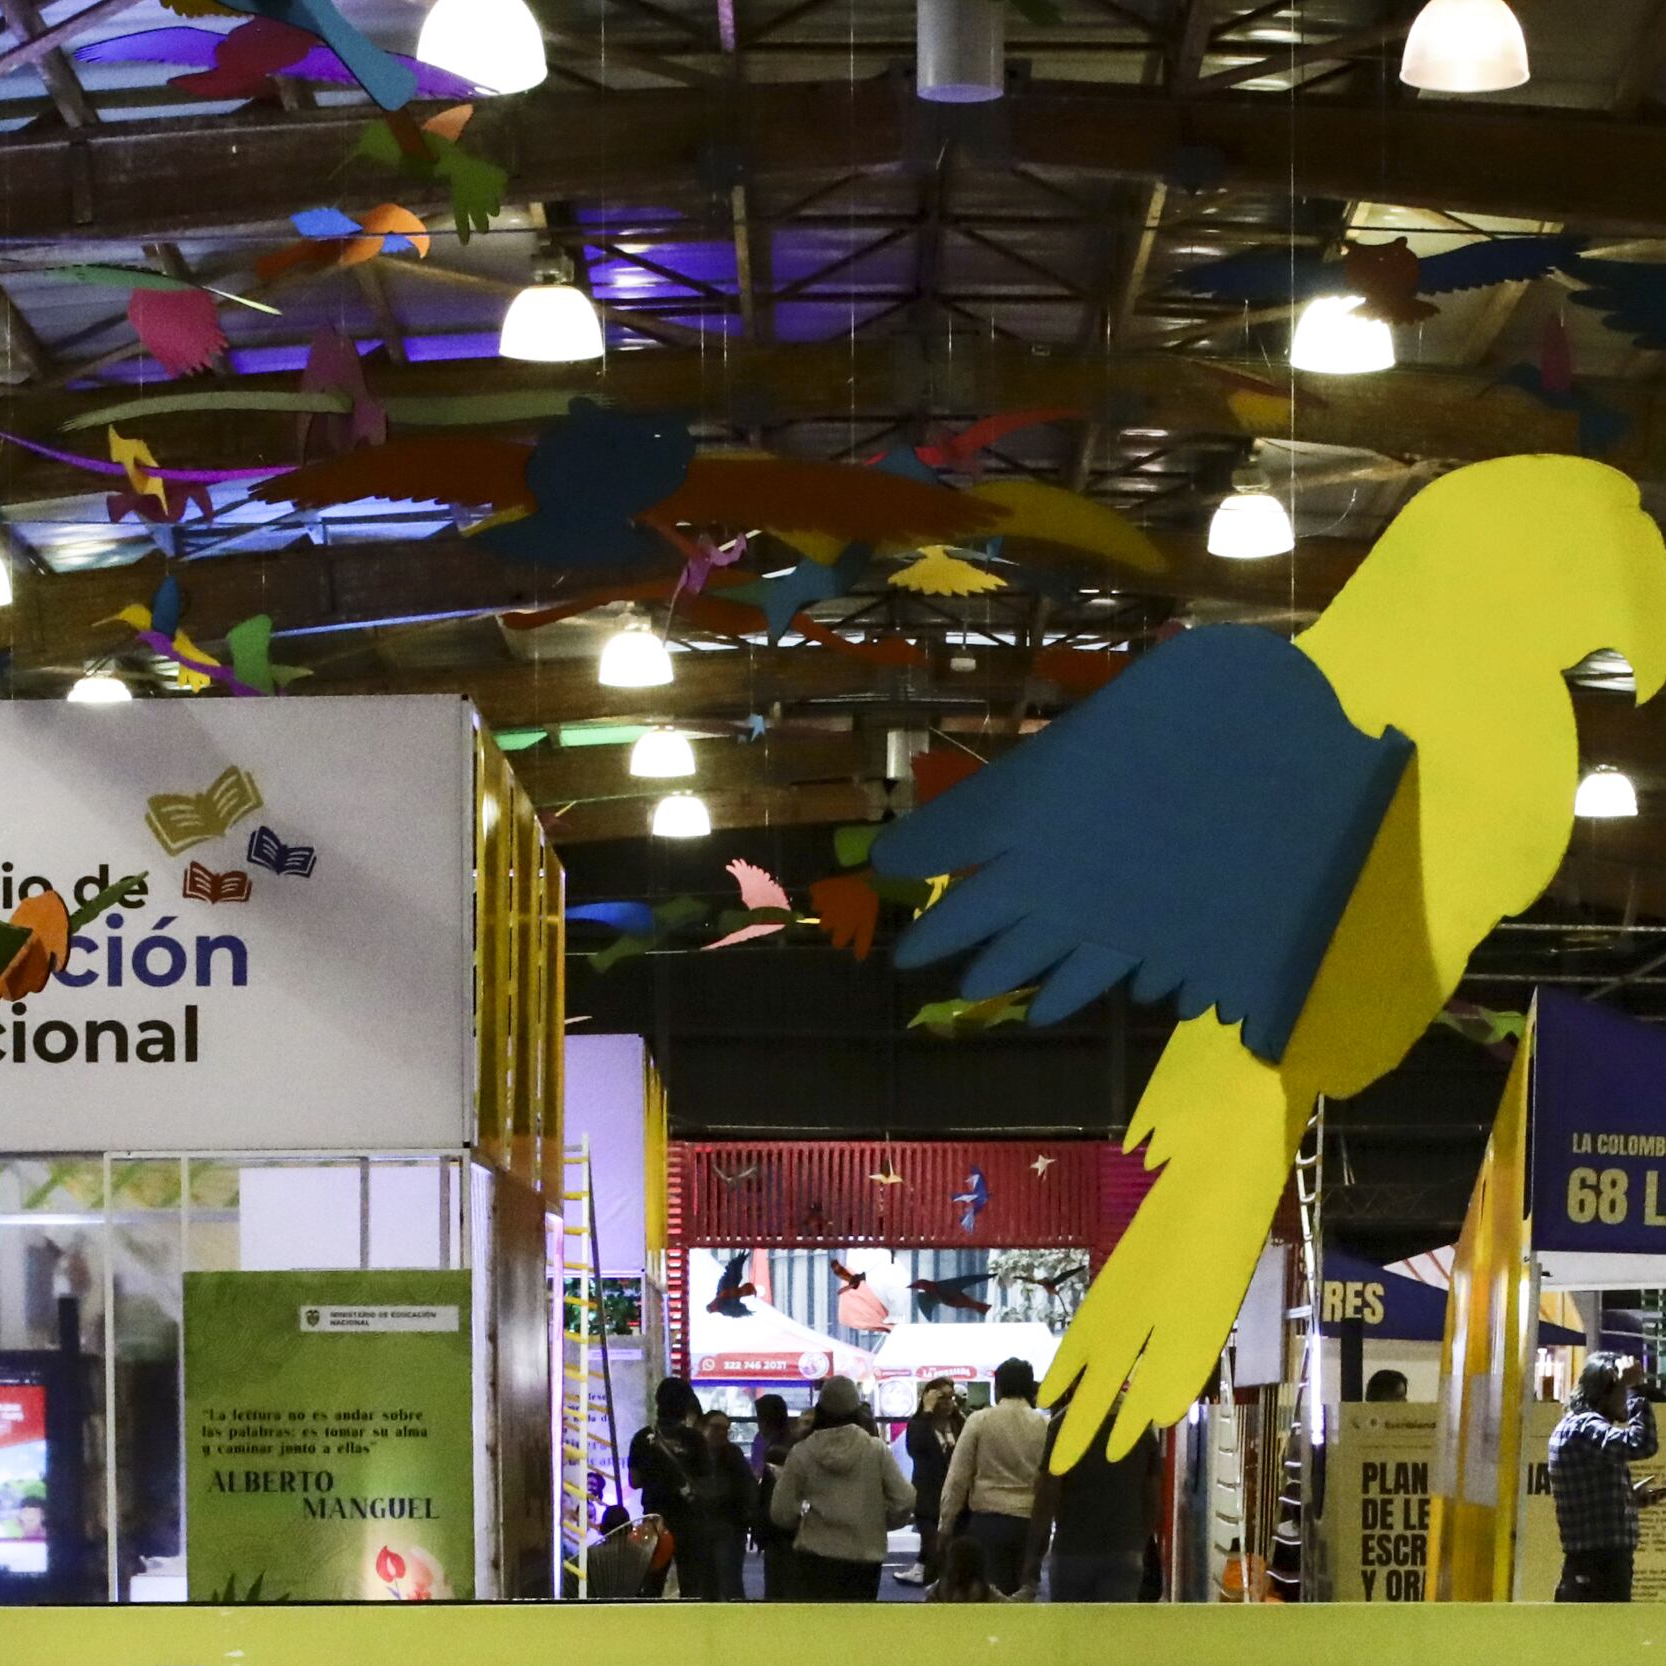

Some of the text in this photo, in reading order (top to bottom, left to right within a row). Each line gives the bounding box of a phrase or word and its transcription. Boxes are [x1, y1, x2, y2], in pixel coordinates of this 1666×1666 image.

[74, 863, 150, 909] de
[1572, 1132, 1594, 1154] LA
[1567, 1167, 1629, 1226] 68
[1323, 1281, 1385, 1325] RES
[232, 1409, 282, 1422] lectura
[288, 1412, 306, 1422] no
[334, 1409, 375, 1422] andar
[382, 1409, 424, 1422] sobre
[207, 1470, 334, 1493] ALBERTO
[1361, 1461, 1429, 1496] PLAN
[302, 1497, 440, 1520] MANGUEL
[1361, 1497, 1394, 1531] DE
[1361, 1571, 1376, 1602] Y
